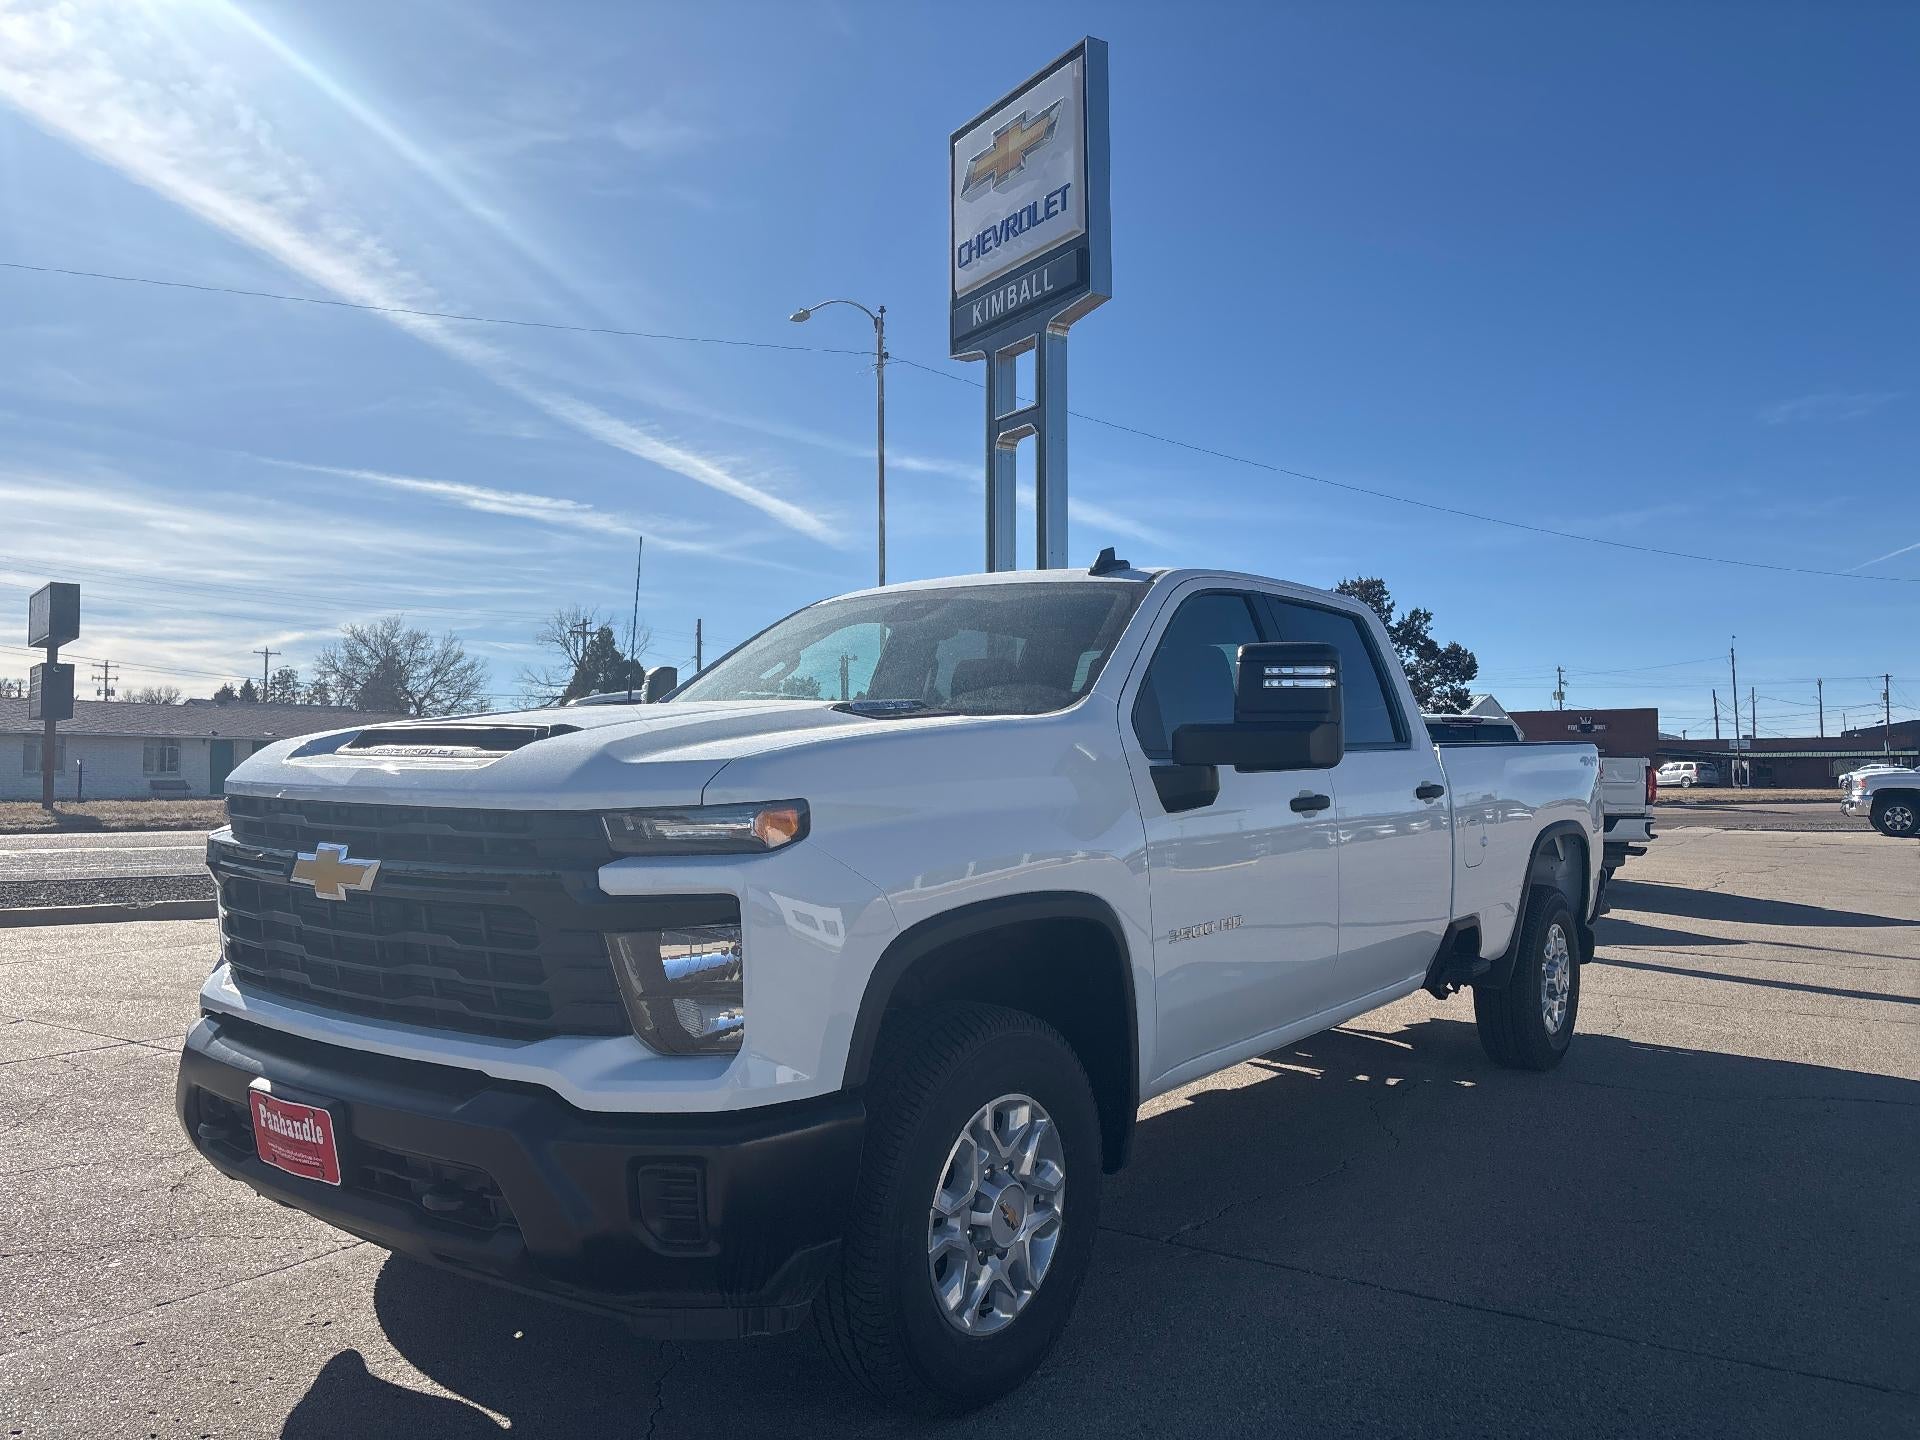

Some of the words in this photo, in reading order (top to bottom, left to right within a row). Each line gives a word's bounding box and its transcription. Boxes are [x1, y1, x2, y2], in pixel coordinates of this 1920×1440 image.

[957, 182, 1071, 269] CHEVROLET
[972, 268, 1054, 327] KIMBALL
[1169, 921, 1216, 944] 3500
[1219, 914, 1244, 932] HD
[258, 1103, 324, 1145] Panhandle
